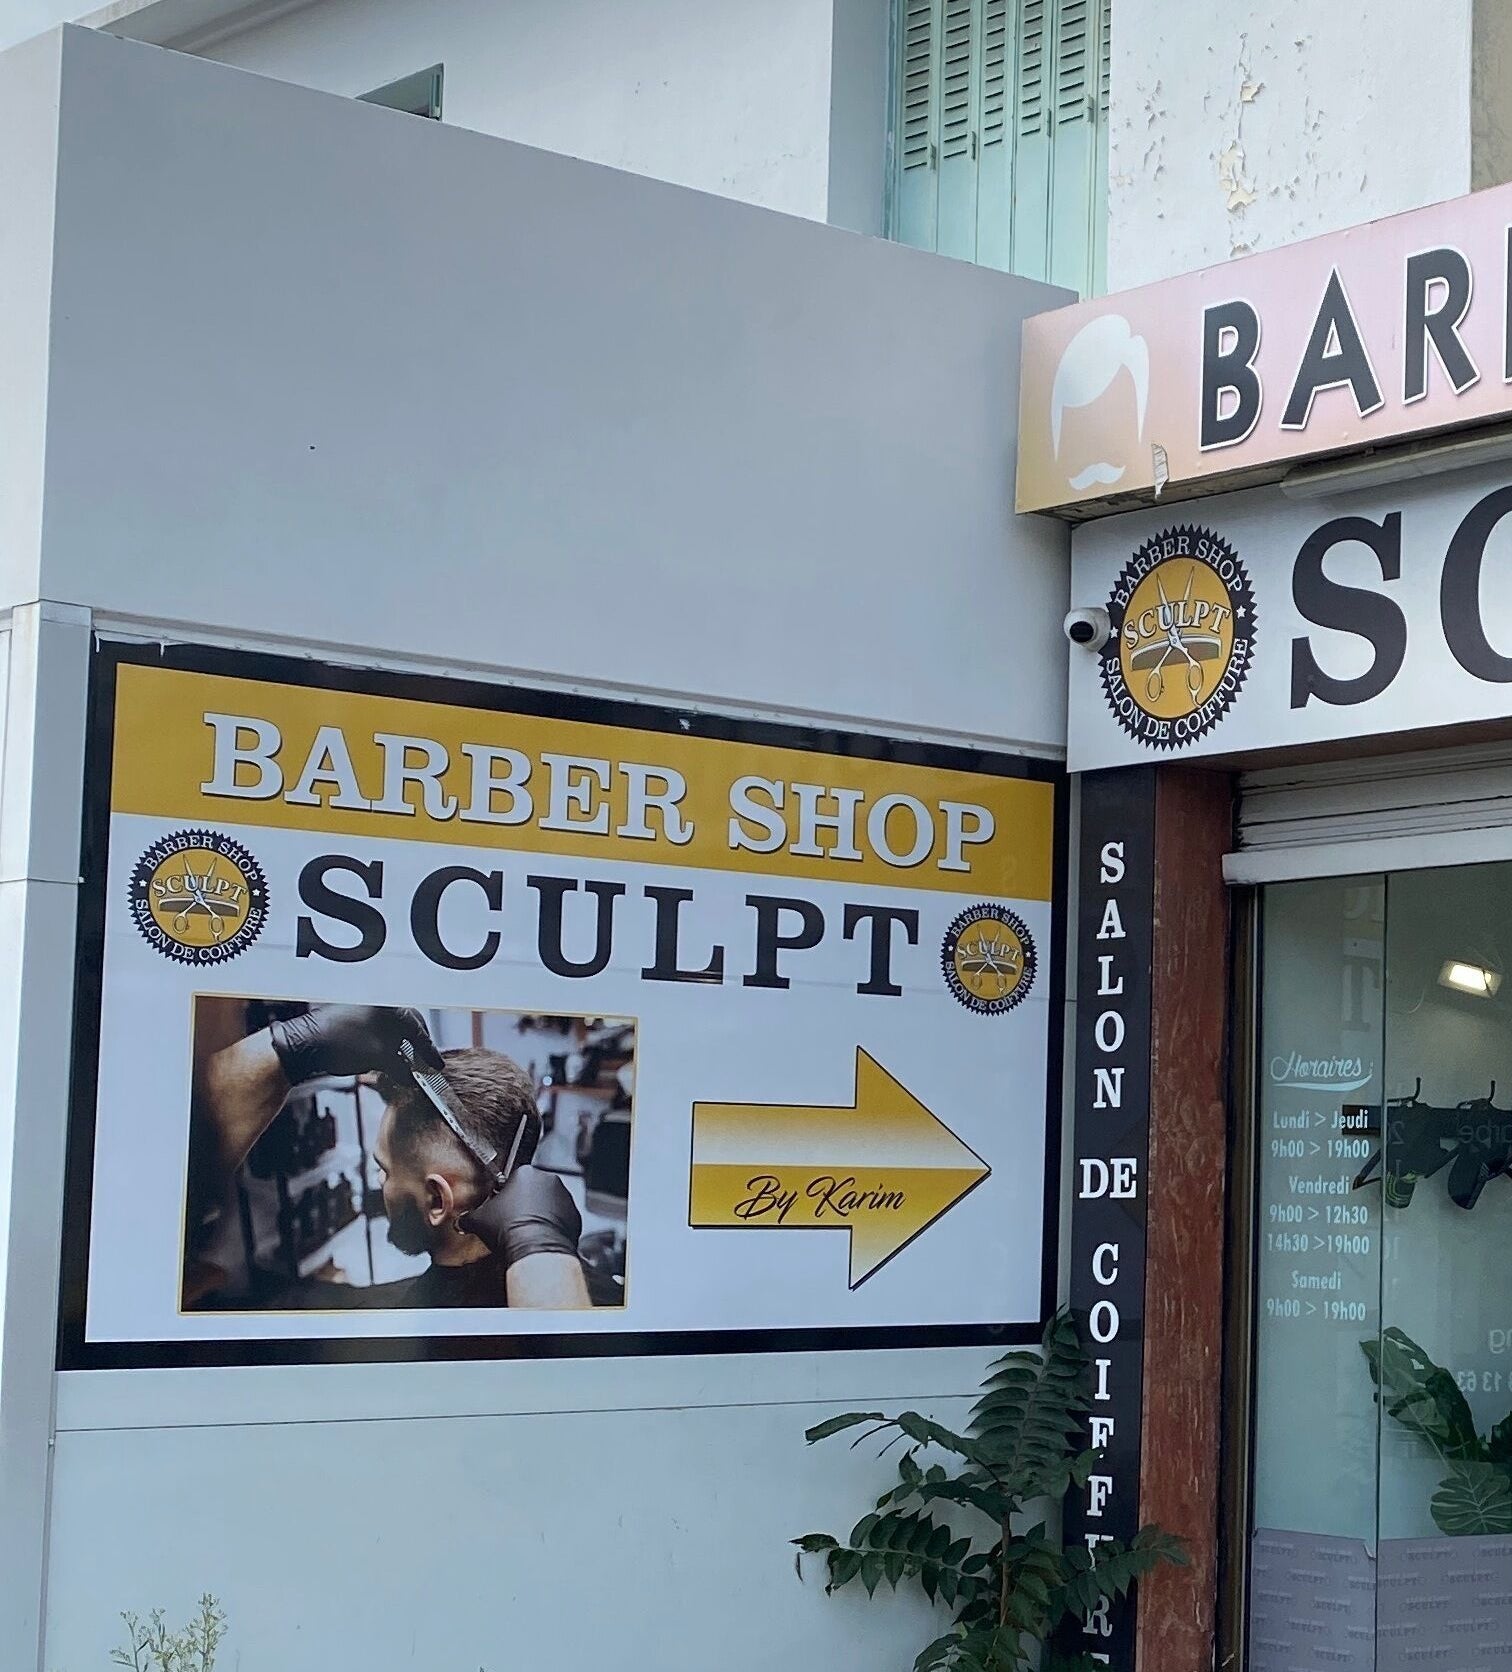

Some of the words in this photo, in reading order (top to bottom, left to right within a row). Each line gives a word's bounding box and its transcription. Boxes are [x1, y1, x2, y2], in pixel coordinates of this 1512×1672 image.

[1114, 535, 1190, 609] BARBER
[1194, 538, 1243, 592] SHOP
[1123, 599, 1232, 648] SCULPT
[1106, 657, 1145, 729] SALON
[1144, 717, 1172, 740] DE
[1174, 638, 1249, 738] COIFFURE
[200, 710, 695, 847] BARBER
[727, 775, 996, 873] SHOP
[143, 834, 214, 871] BARBER
[218, 841, 258, 881] SHOP
[151, 874, 248, 902] SCULPT
[135, 899, 171, 948] SALON
[171, 945, 196, 960] DE
[198, 907, 262, 960] COIFFURE
[295, 854, 920, 997] SCULPT
[951, 907, 1000, 938] BARBER
[1002, 912, 1030, 945] SHOP
[957, 940, 1020, 961] SCULPT
[945, 961, 972, 1001] SALON
[970, 999, 988, 1011] DE
[988, 966, 1033, 1011] COIFFURE
[1093, 840, 1127, 1110] SALON
[1270, 1050, 1362, 1082] Horaires
[1273, 1110, 1310, 1129] Lundi
[1331, 1109, 1369, 1129] Jeudi
[1271, 1139, 1304, 1159] 9h00
[1327, 1139, 1370, 1159] 19h00
[734, 1174, 798, 1222] By
[805, 1175, 907, 1219] Karim
[1079, 1158, 1138, 1200] DE
[1288, 1175, 1350, 1196] Vendredi
[1269, 1206, 1303, 1224] 9h00
[1325, 1205, 1368, 1225] 12h30
[1267, 1233, 1309, 1253] 14h30
[1291, 1270, 1342, 1291] Samedi
[1266, 1299, 1300, 1319] 9h00
[1323, 1300, 1367, 1321] 19h00
[1082, 1242, 1120, 1667] COIFFR
